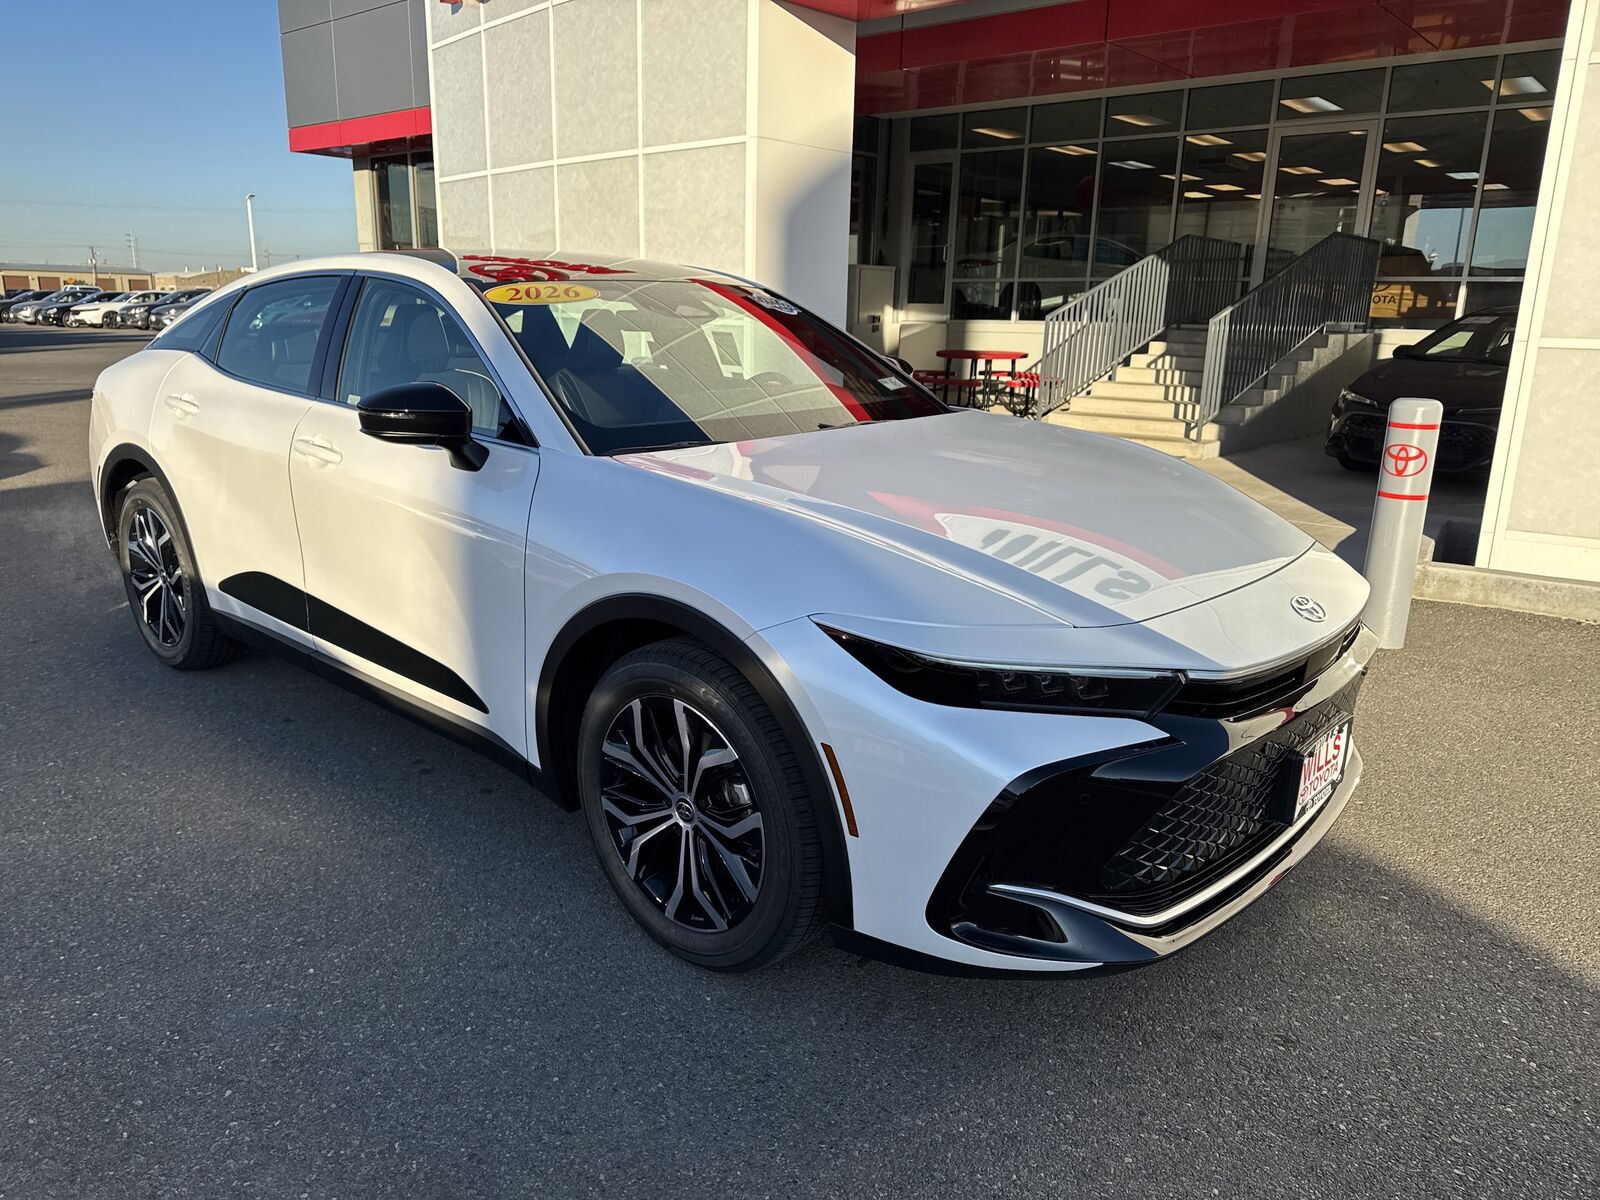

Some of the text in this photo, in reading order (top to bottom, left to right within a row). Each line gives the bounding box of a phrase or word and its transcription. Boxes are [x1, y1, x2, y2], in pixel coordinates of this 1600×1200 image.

[505, 286, 580, 301] 2026
[1372, 295, 1397, 304] OTA
[1303, 733, 1341, 786] WILLS
[1309, 761, 1338, 796] TOYOTA
